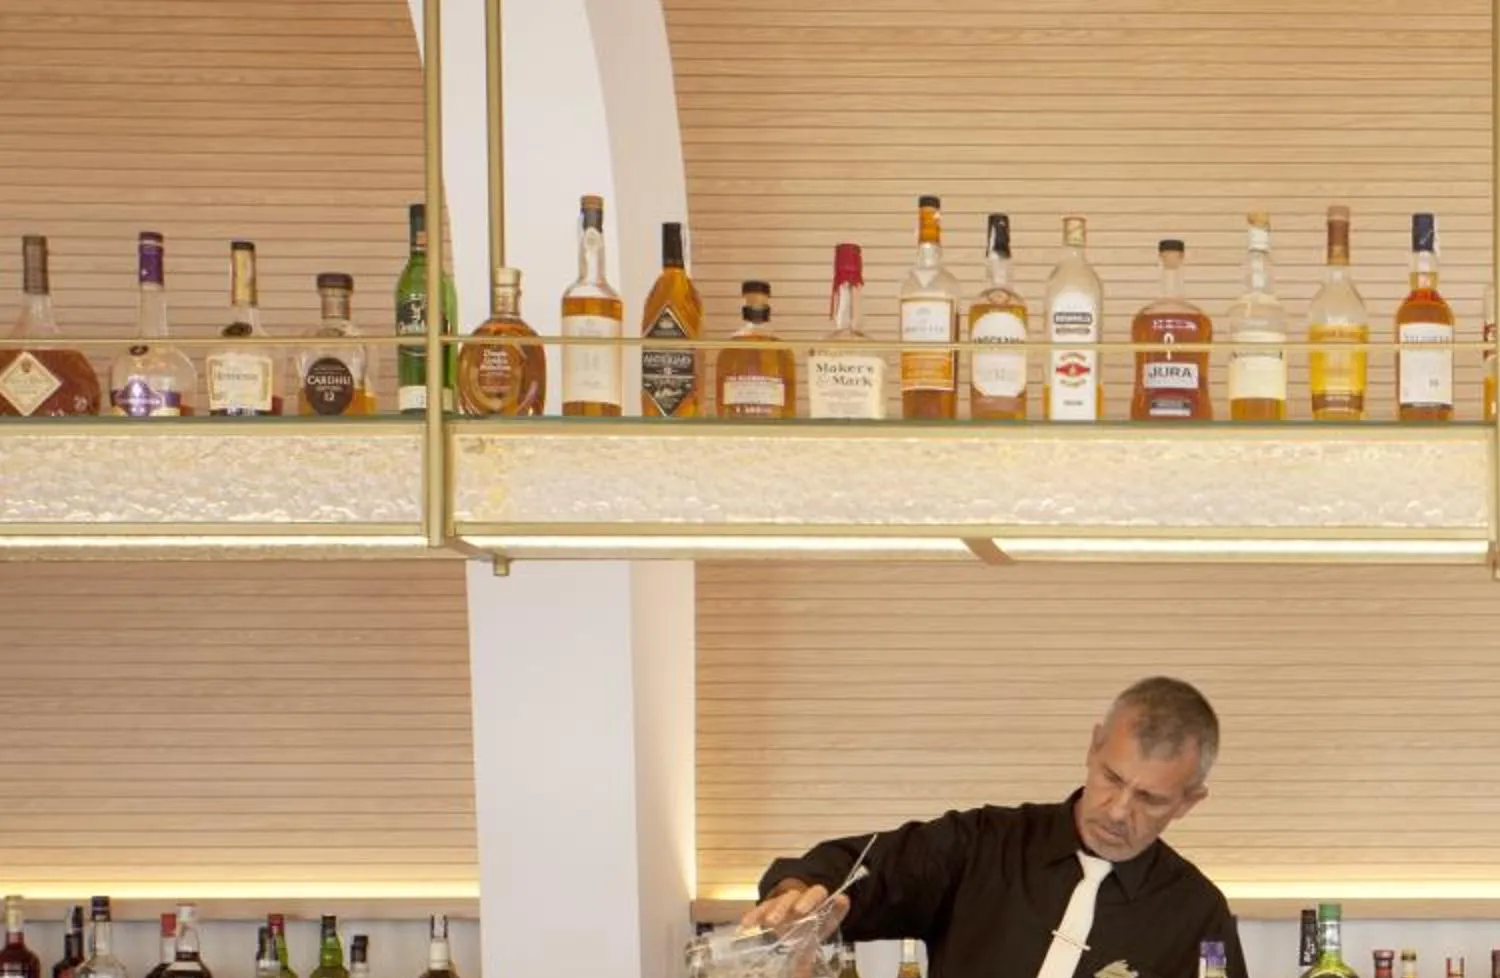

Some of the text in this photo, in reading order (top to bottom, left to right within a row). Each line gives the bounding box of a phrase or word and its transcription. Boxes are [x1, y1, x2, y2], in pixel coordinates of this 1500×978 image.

[816, 361, 874, 373] Maker's
[1148, 366, 1192, 378] JURA
[832, 375, 872, 388] Mark
